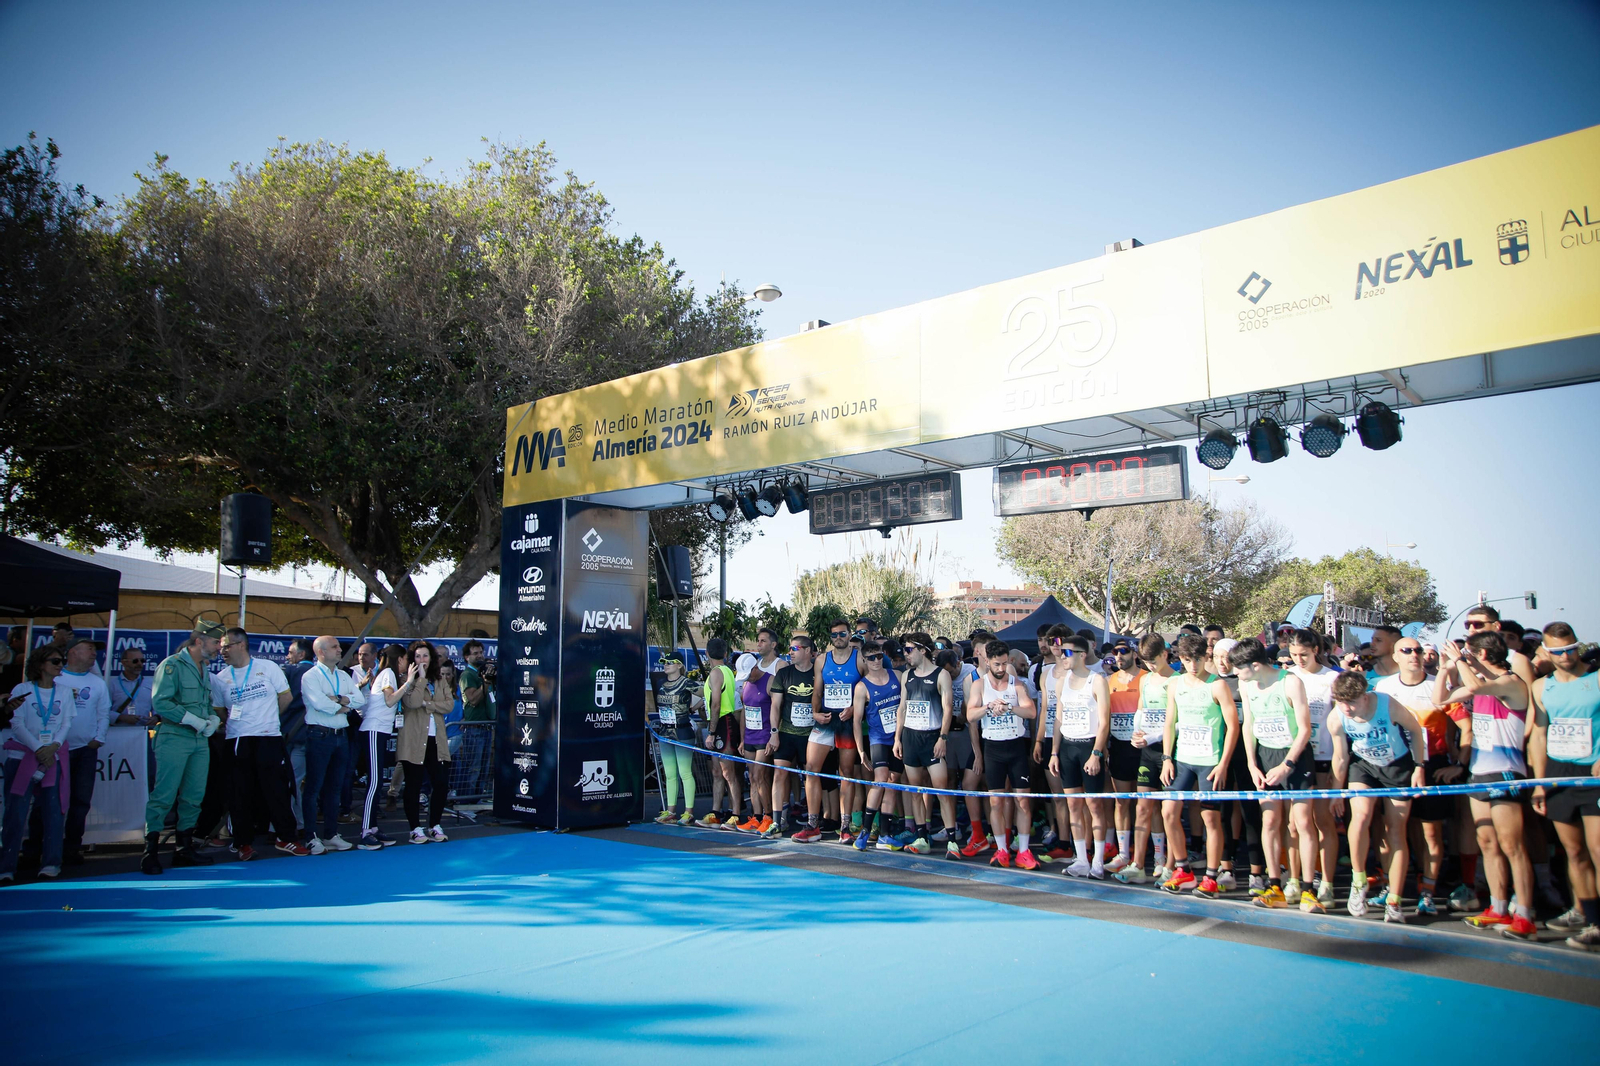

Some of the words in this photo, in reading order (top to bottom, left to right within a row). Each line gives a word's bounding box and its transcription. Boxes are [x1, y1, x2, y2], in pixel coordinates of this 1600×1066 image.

[1363, 287, 1386, 298] 2020
[1238, 294, 1330, 321] COOPERACIÓN
[1002, 273, 1117, 382] 25
[1239, 318, 1269, 332] 2005
[759, 383, 790, 396] RFEA
[1003, 371, 1119, 412] EDICIÓN
[754, 405, 773, 413] RUTA
[774, 398, 806, 410] RUNNING
[756, 394, 787, 405] SERIES
[594, 414, 638, 436] Medio
[644, 398, 713, 427] Maratón
[723, 419, 768, 439] RAMÓN
[774, 413, 805, 429] RUIZ
[811, 398, 878, 423] ANDÚJAR
[568, 424, 583, 442] 25
[592, 430, 657, 462] Almería
[660, 420, 713, 449] 2024
[511, 535, 552, 553] cajamar
[581, 554, 633, 566] COOPERACIÓN
[581, 562, 599, 570] 2005
[518, 585, 546, 594] HYUNDAI
[1305, 601, 1315, 619] azul
[827, 688, 849, 697] 5610
[585, 710, 623, 722] ALMERÍA
[883, 710, 898, 721] 57
[990, 716, 1014, 725] 5541
[1064, 711, 1086, 720] 5492
[1257, 723, 1285, 733] 5686
[1550, 725, 1586, 736] 5924
